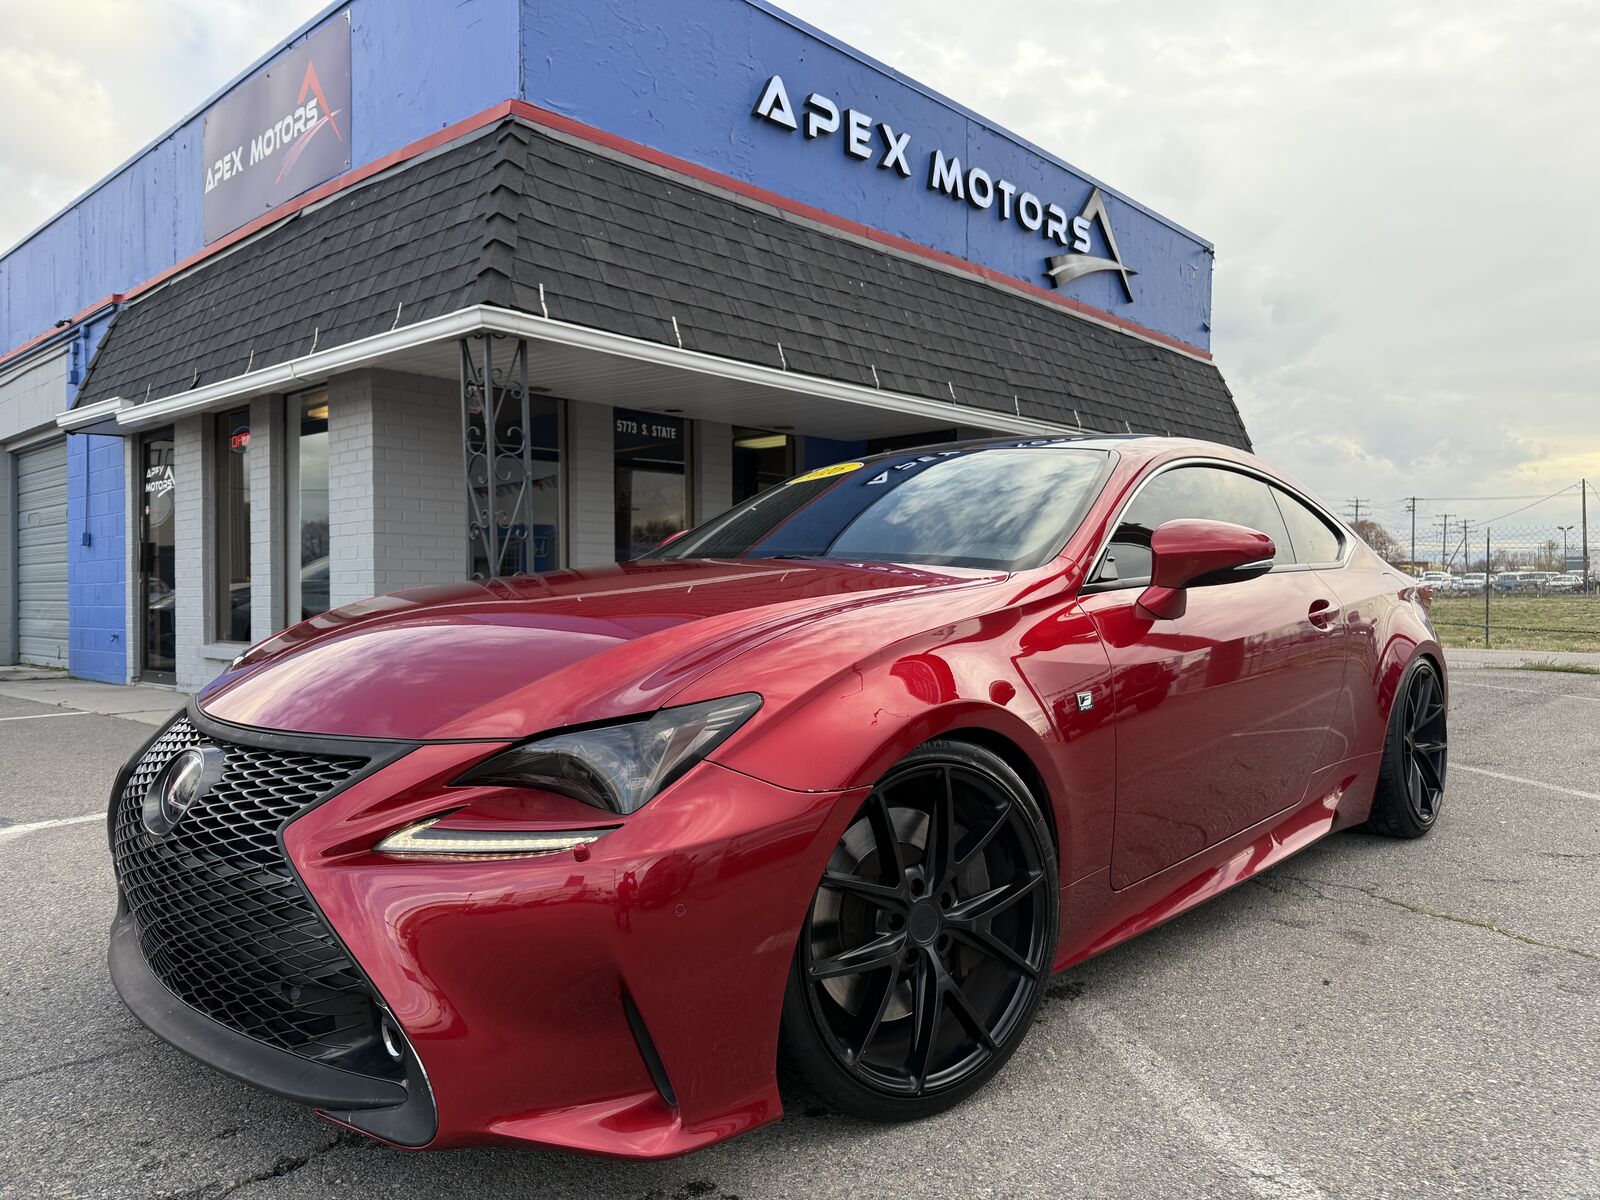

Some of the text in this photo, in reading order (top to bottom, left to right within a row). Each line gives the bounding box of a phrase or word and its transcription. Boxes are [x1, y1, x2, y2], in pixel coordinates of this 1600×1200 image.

[205, 97, 319, 194] APEX MOTORS
[752, 74, 1092, 254] APEX MOTORS
[616, 420, 638, 434] 5773
[651, 425, 677, 439] STATE
[145, 479, 173, 493] MOTORS
